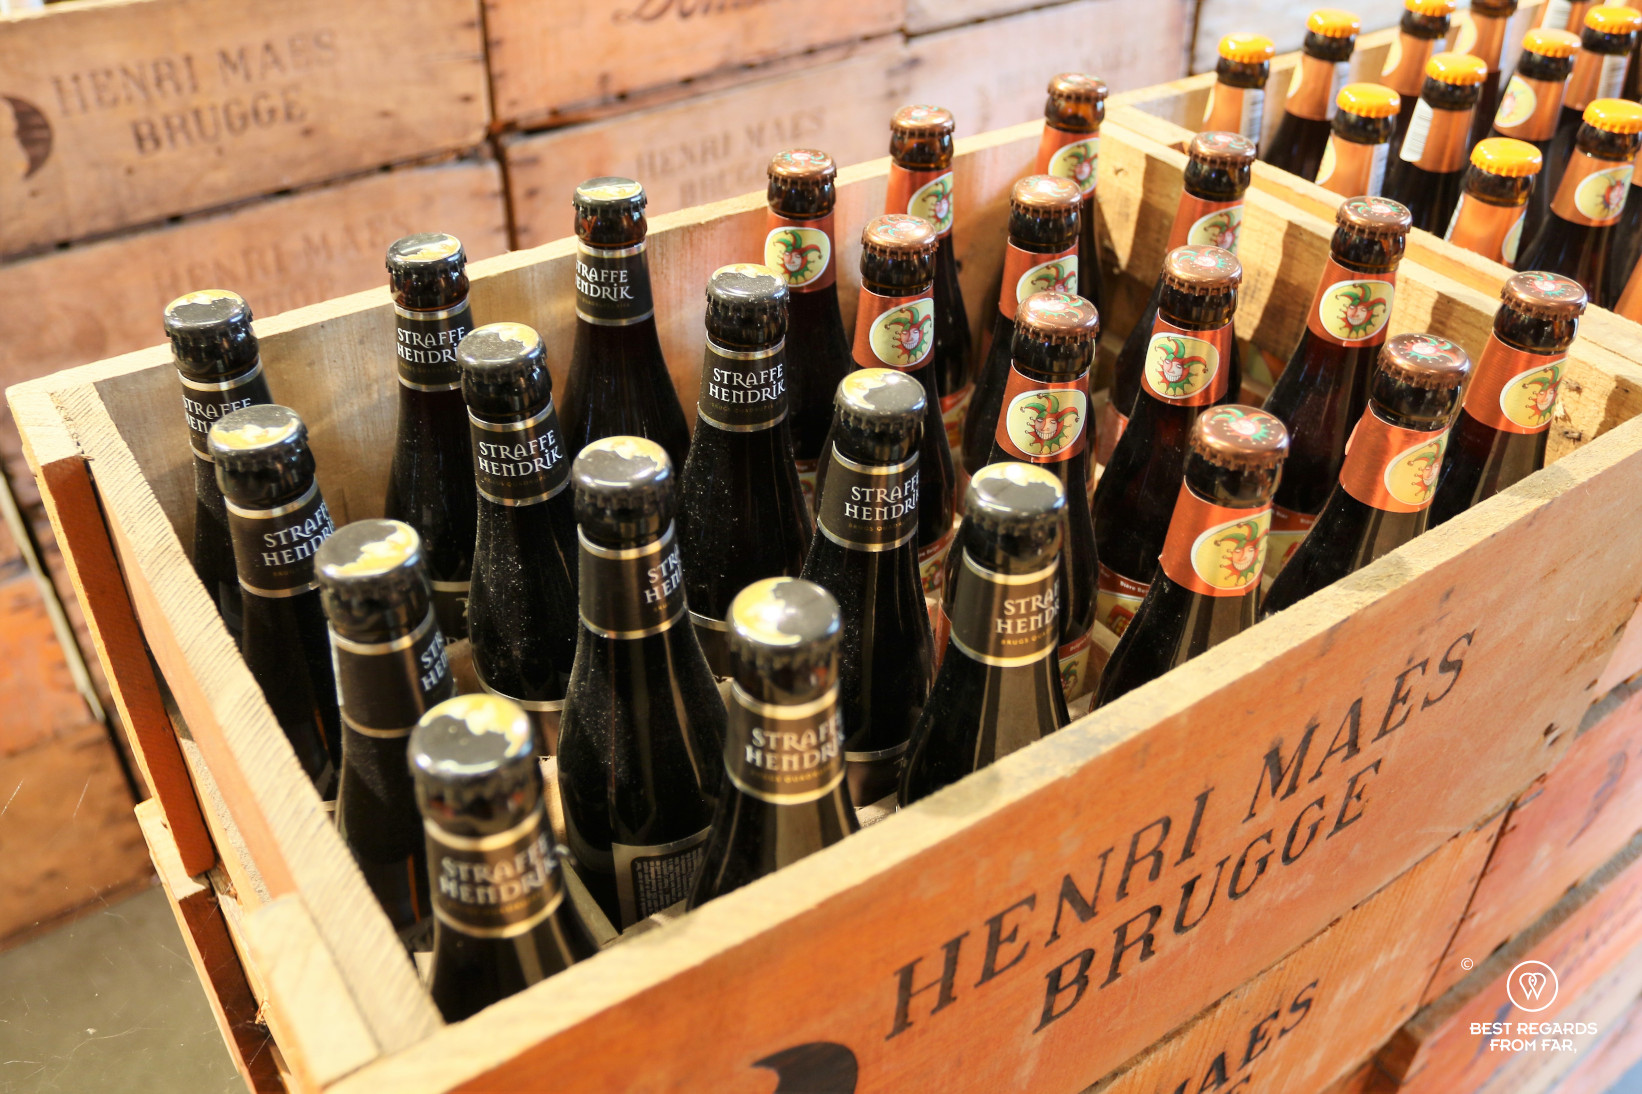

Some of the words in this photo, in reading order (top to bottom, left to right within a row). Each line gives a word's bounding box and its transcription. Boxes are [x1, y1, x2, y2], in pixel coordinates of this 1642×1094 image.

[52, 53, 198, 119] HENRI
[218, 29, 340, 88] MAES
[131, 87, 308, 155] BRUGGE
[396, 326, 466, 349] STRAFFE
[396, 341, 459, 364] HENDRI
[713, 363, 784, 389] STRAFFE
[478, 430, 556, 462] STRAFFE
[885, 786, 1215, 1042] HENRI
[1241, 629, 1477, 824] MAES
[1031, 757, 1383, 1036] BRUGGE
